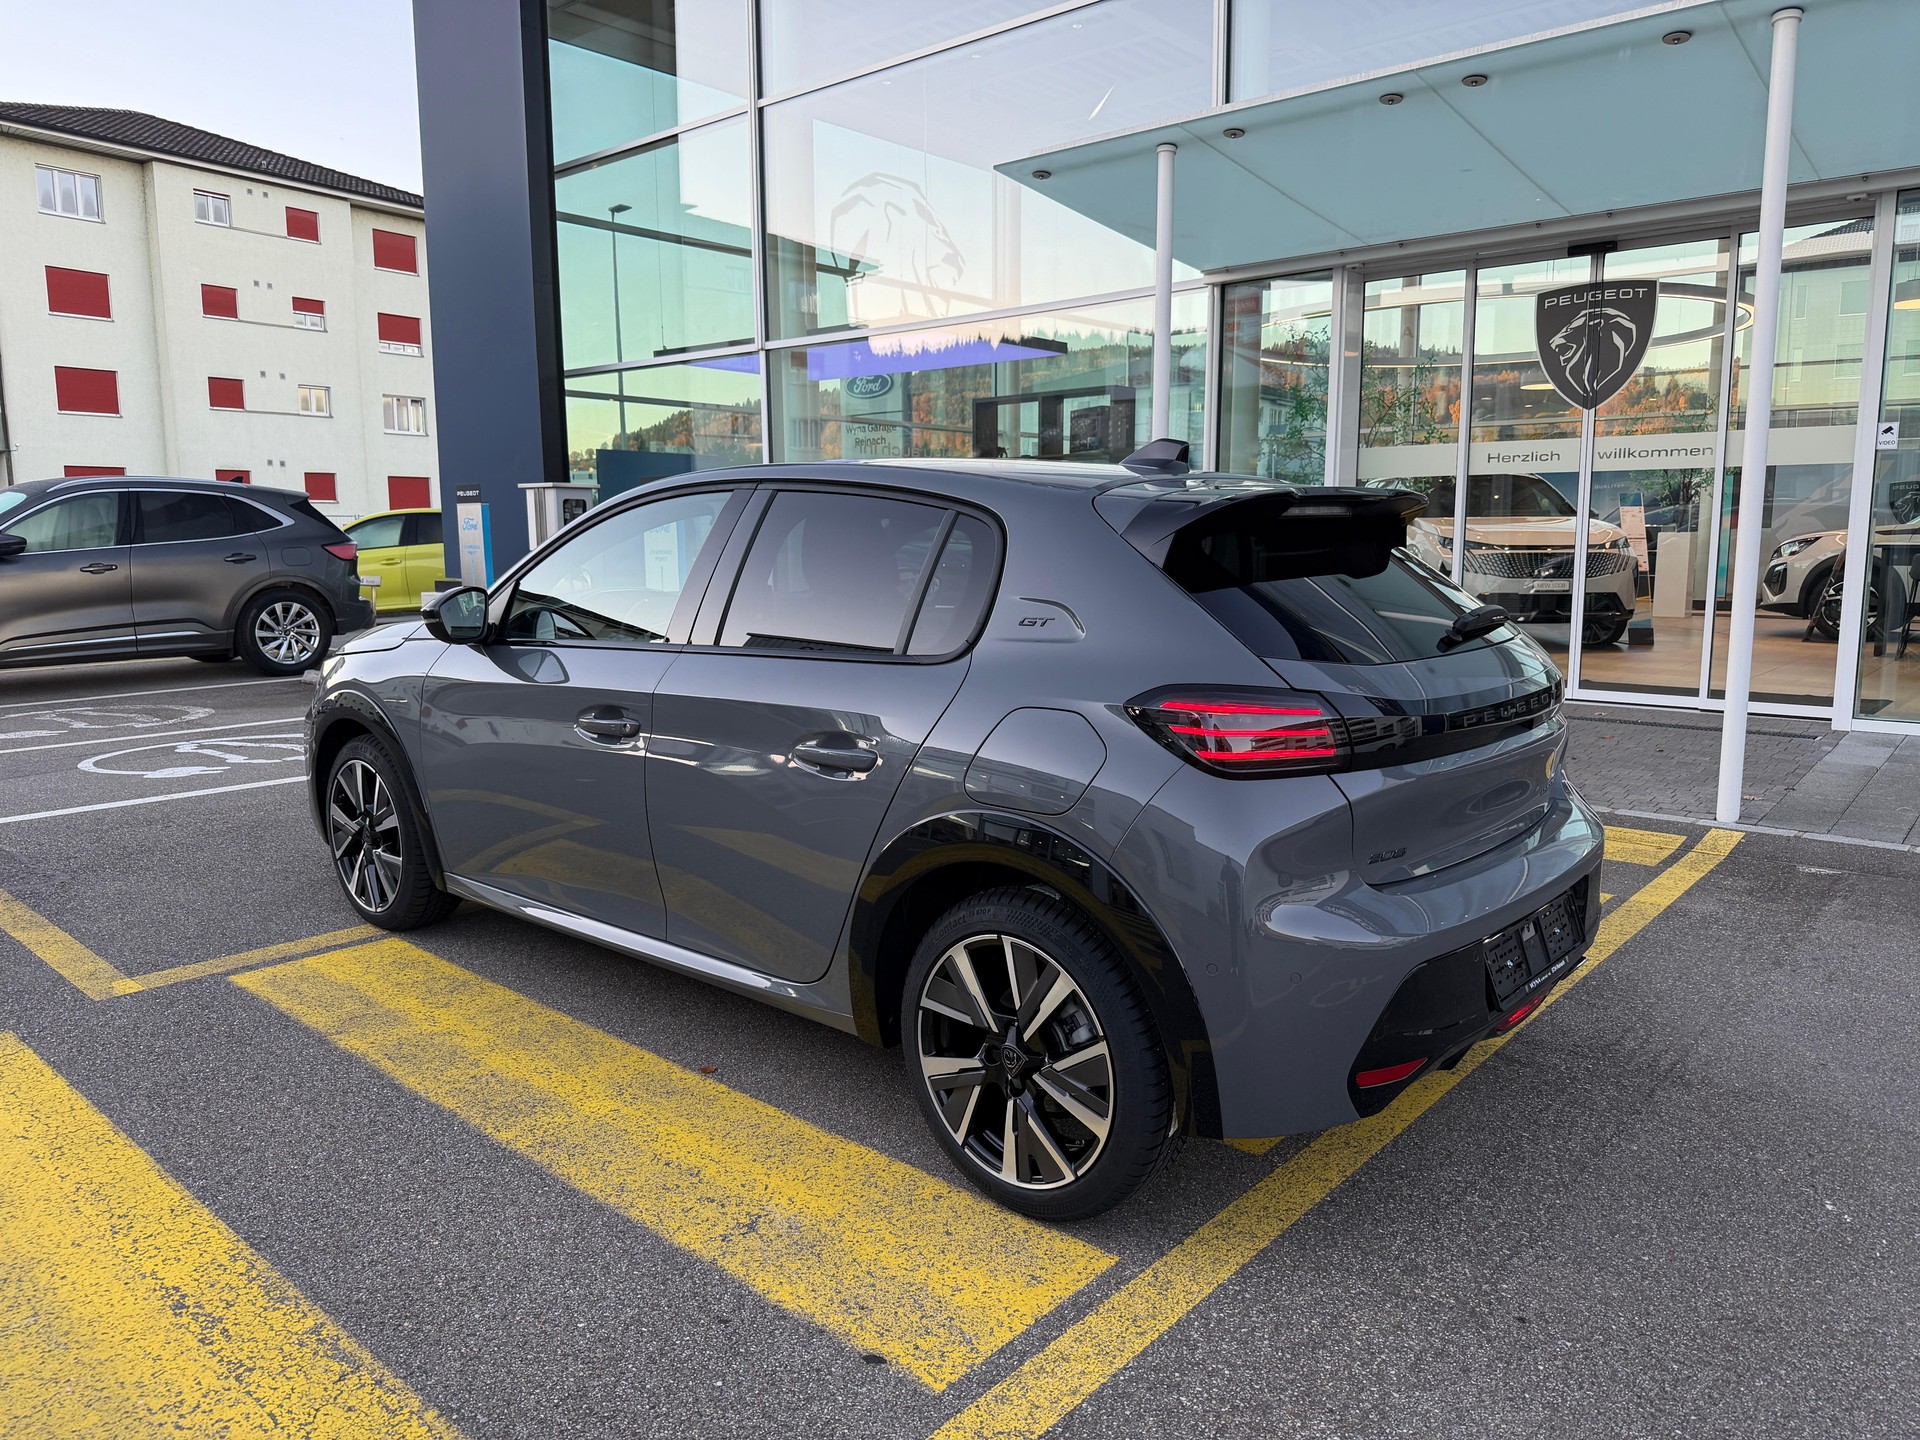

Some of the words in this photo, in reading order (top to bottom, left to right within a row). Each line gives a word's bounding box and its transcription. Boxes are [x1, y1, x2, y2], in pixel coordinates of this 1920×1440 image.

[1544, 288, 1648, 309] PEUGEOT
[854, 376, 881, 393] Ford
[867, 424, 897, 433] Garage
[855, 436, 886, 447] Reinach
[1487, 451, 1561, 463] Herzlich
[1597, 446, 1714, 460] willkommen
[462, 518, 479, 531] Ford
[1018, 617, 1056, 628] GT
[1367, 848, 1407, 865] 208
